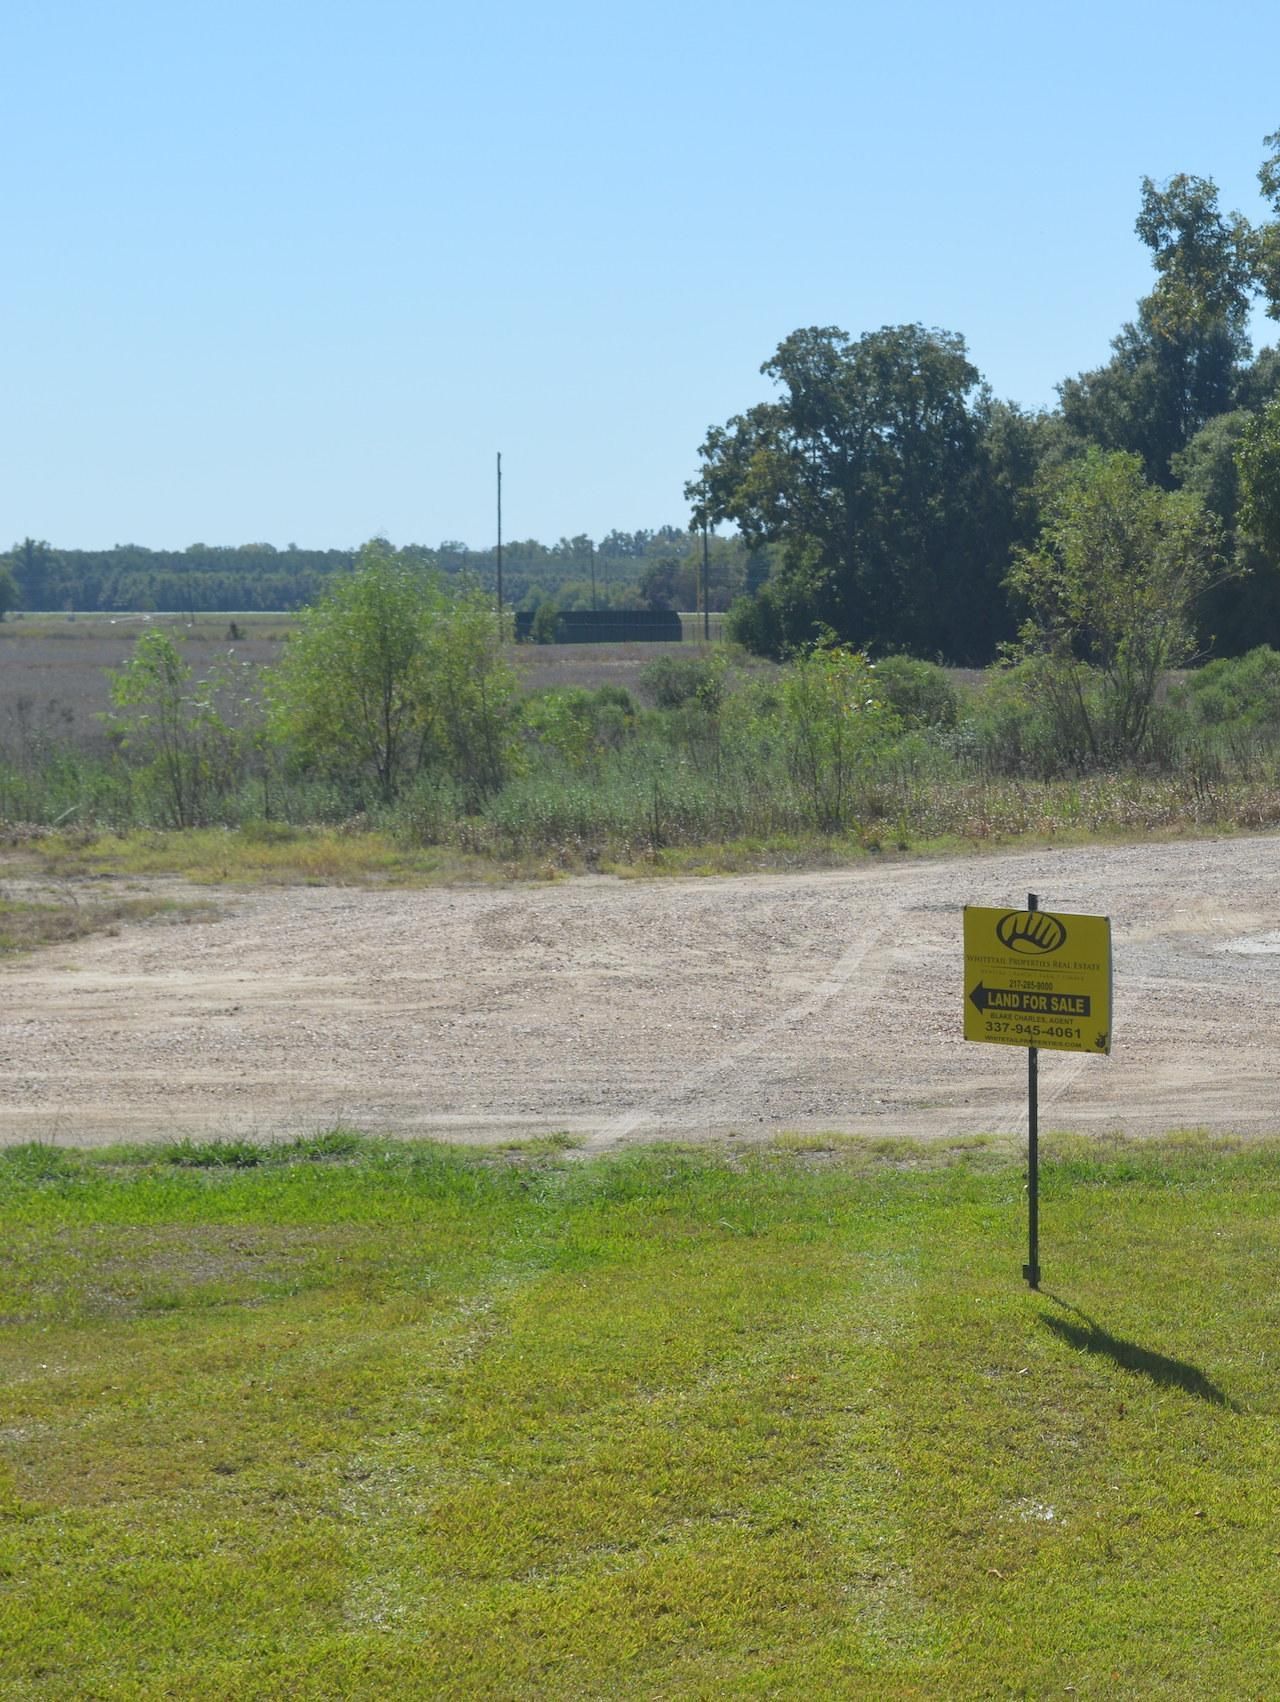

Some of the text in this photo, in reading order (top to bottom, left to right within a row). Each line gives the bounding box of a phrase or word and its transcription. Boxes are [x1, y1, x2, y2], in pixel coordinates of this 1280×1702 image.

[1053, 960, 1071, 969] REAL
[988, 992, 1085, 1013] LAND FOR SALE
[990, 1012, 1012, 1020] BLAKE
[1050, 1016, 1074, 1025] AGENT
[985, 1021, 1082, 1039] 337-945-4061
